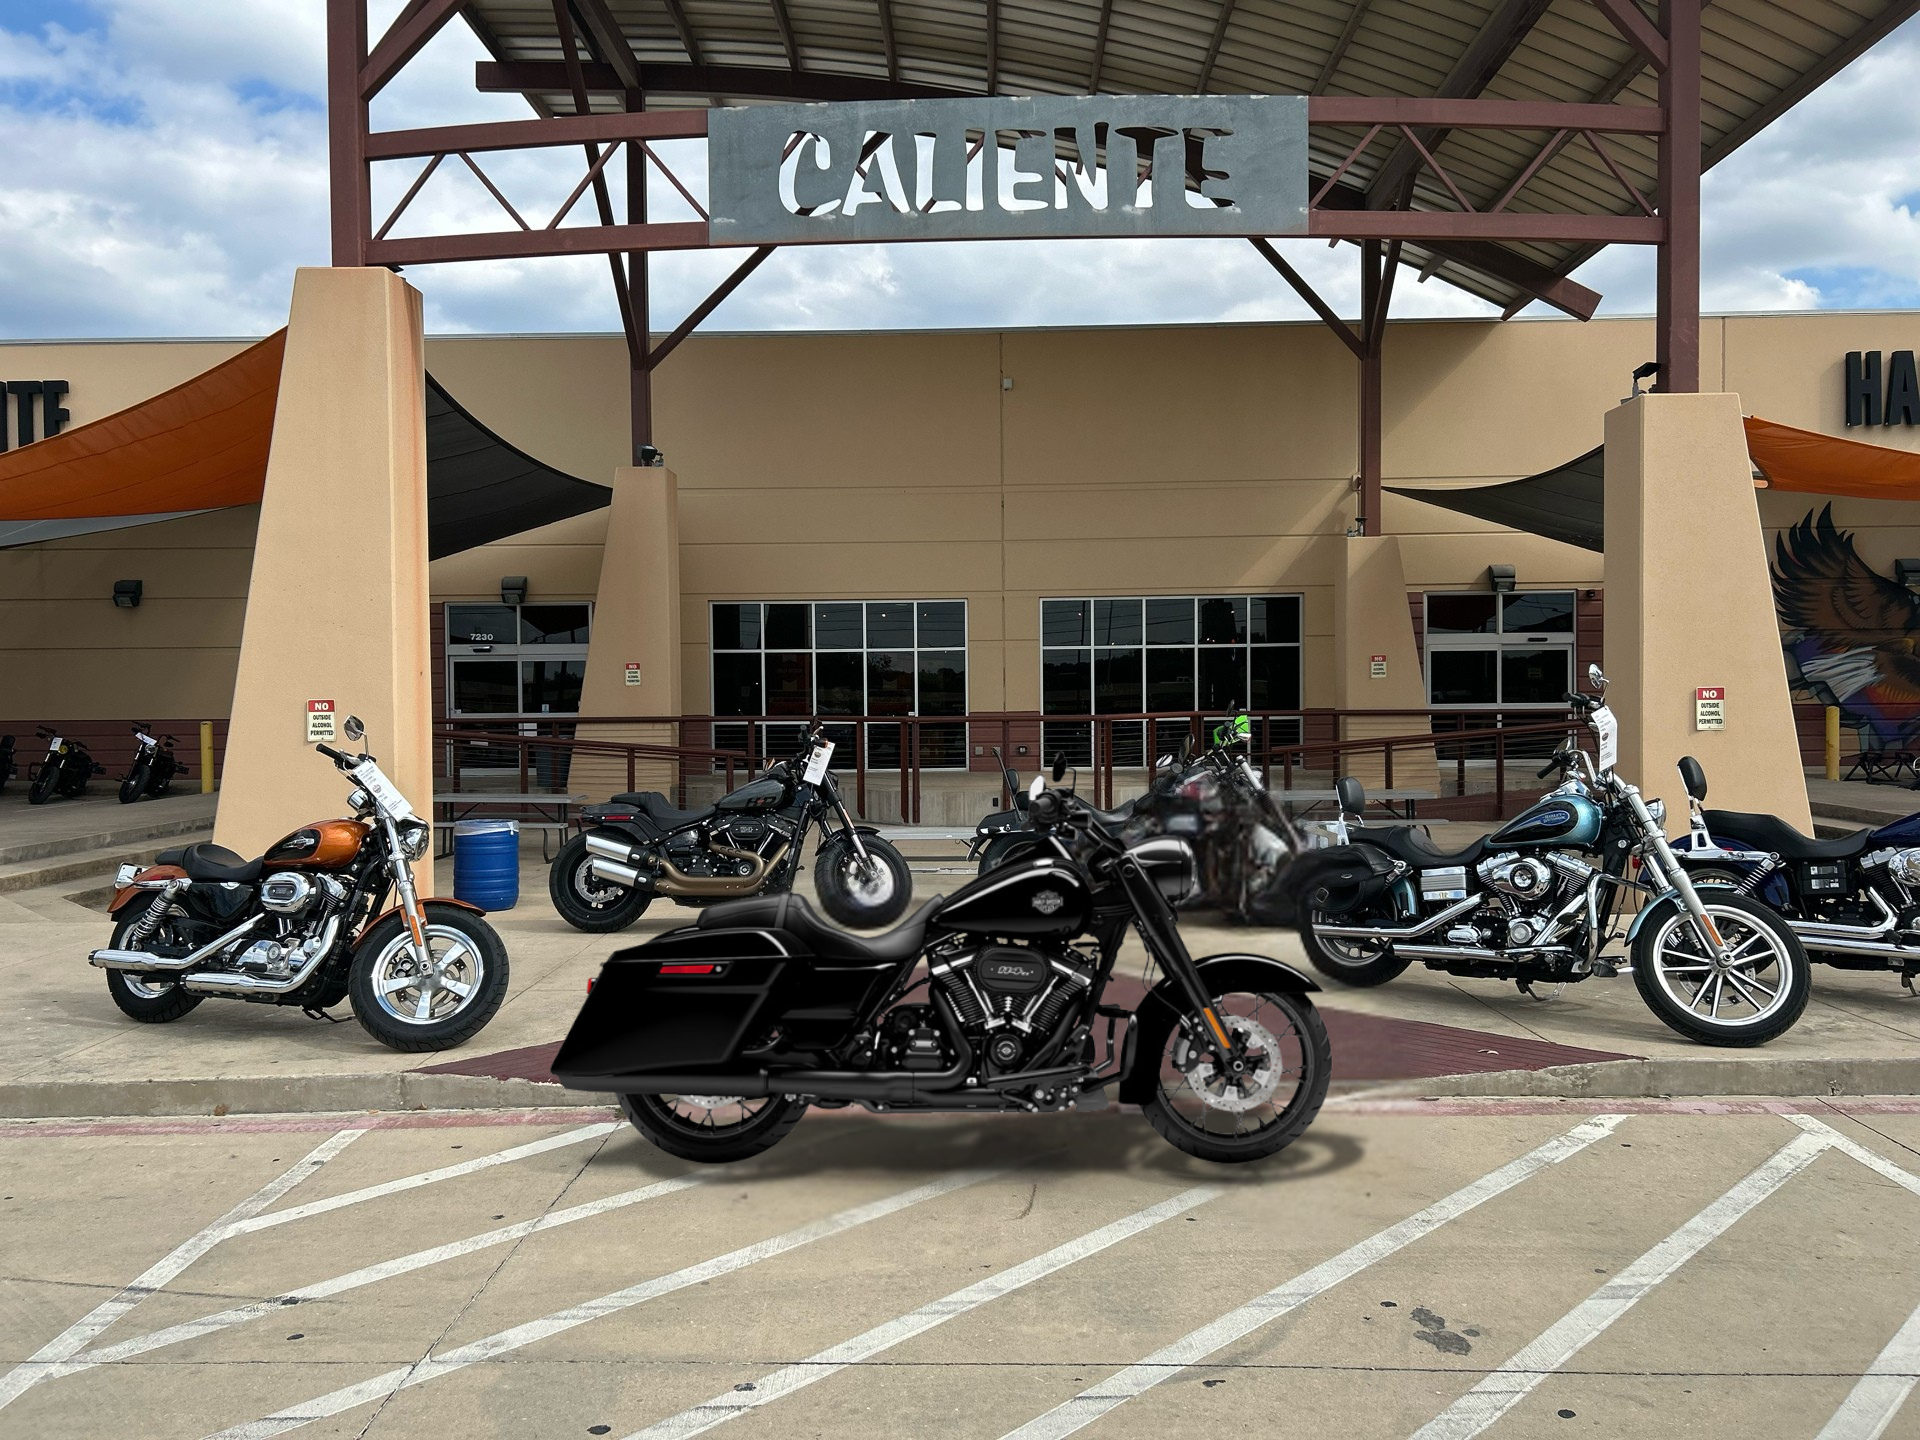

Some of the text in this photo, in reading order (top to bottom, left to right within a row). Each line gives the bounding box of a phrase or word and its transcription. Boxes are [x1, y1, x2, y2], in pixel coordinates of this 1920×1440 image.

[778, 122, 1235, 217] CALIENTE
[1845, 350, 1920, 427] HA
[470, 633, 494, 641] 7230
[1702, 690, 1718, 699] NO
[314, 702, 329, 711] NO
